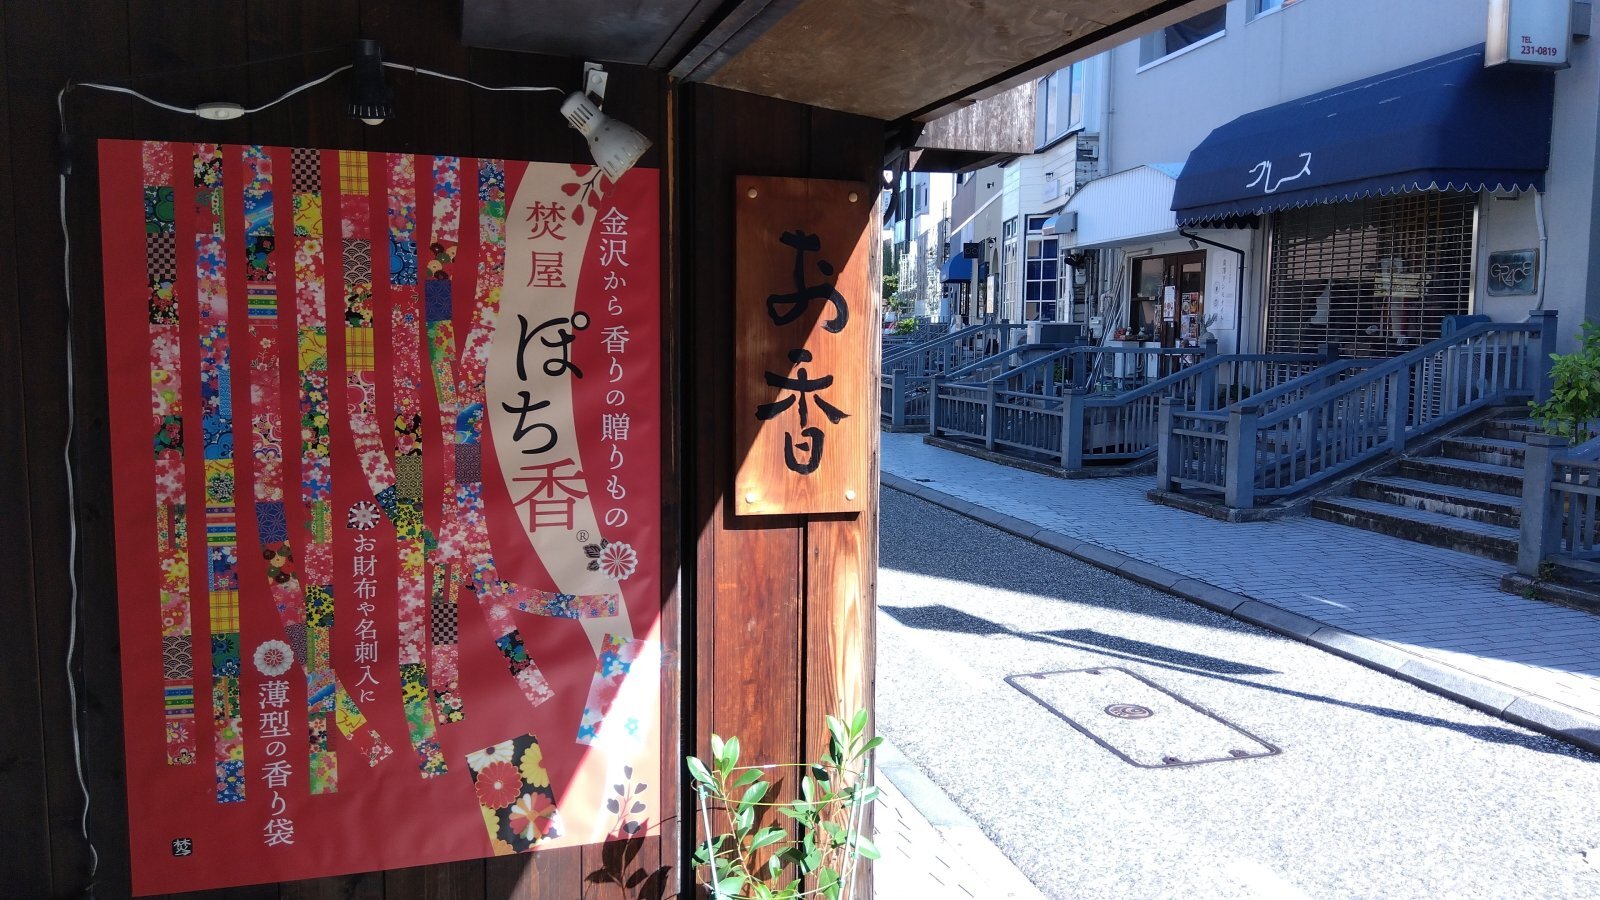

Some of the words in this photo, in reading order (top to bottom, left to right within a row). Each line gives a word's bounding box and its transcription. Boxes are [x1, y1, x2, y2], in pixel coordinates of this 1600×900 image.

[1521, 45, 1557, 56] 231-0819
[525, 200, 567, 289] 焚屋
[1491, 261, 1532, 287] GRACE
[501, 311, 590, 533] ぽち香
[599, 206, 630, 529] 金沢から香りの贈りもの
[755, 229, 852, 475] お香
[352, 534, 380, 703] お財布や名刺入に
[257, 680, 295, 847] 薄型の香り袋
